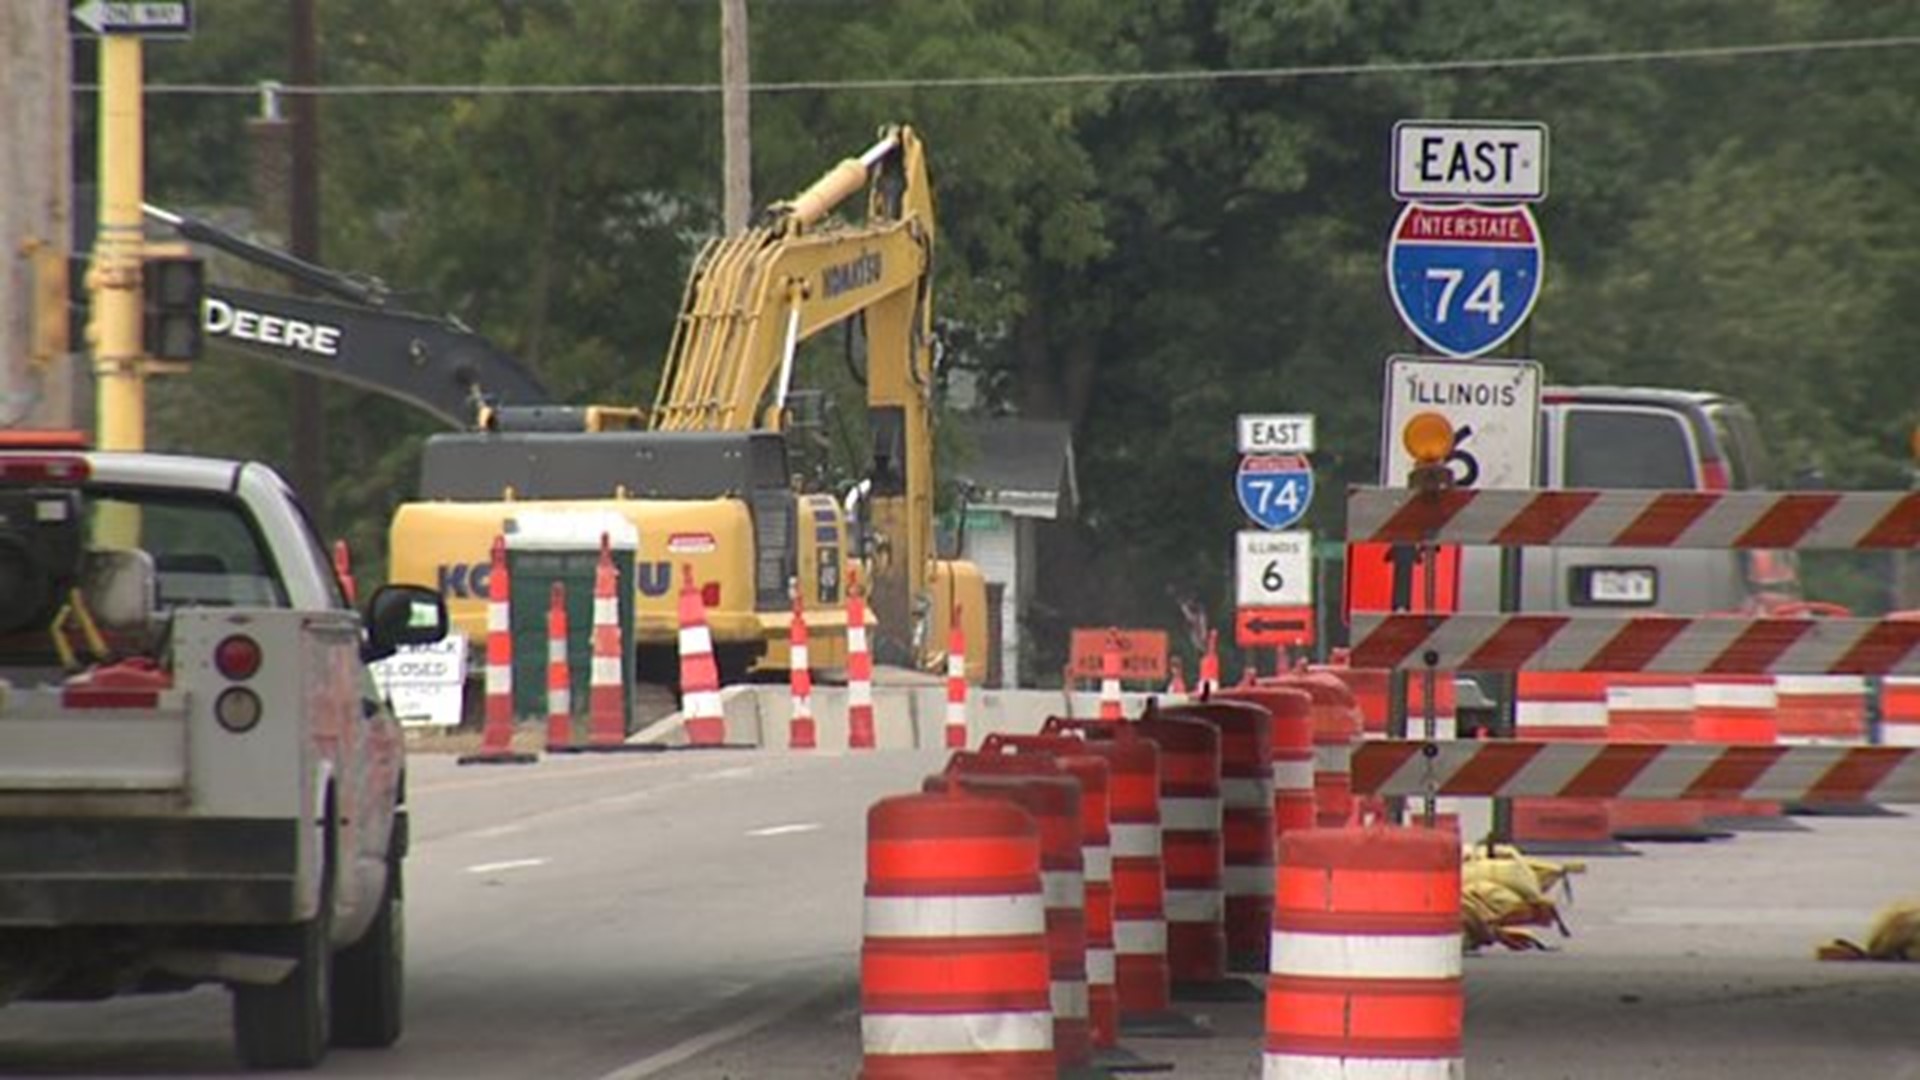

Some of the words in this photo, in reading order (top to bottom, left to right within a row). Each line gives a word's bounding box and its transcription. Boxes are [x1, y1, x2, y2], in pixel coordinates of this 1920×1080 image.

[1421, 137, 1519, 183] EAST
[1412, 213, 1521, 237] INTERSTATE
[1425, 268, 1505, 325] 74
[203, 298, 341, 356] DEERE
[1410, 377, 1516, 407] ILLINOIS
[1251, 423, 1304, 445] EAST
[1444, 424, 1479, 486] 6
[1247, 479, 1299, 514] 74
[1261, 560, 1284, 592] 6
